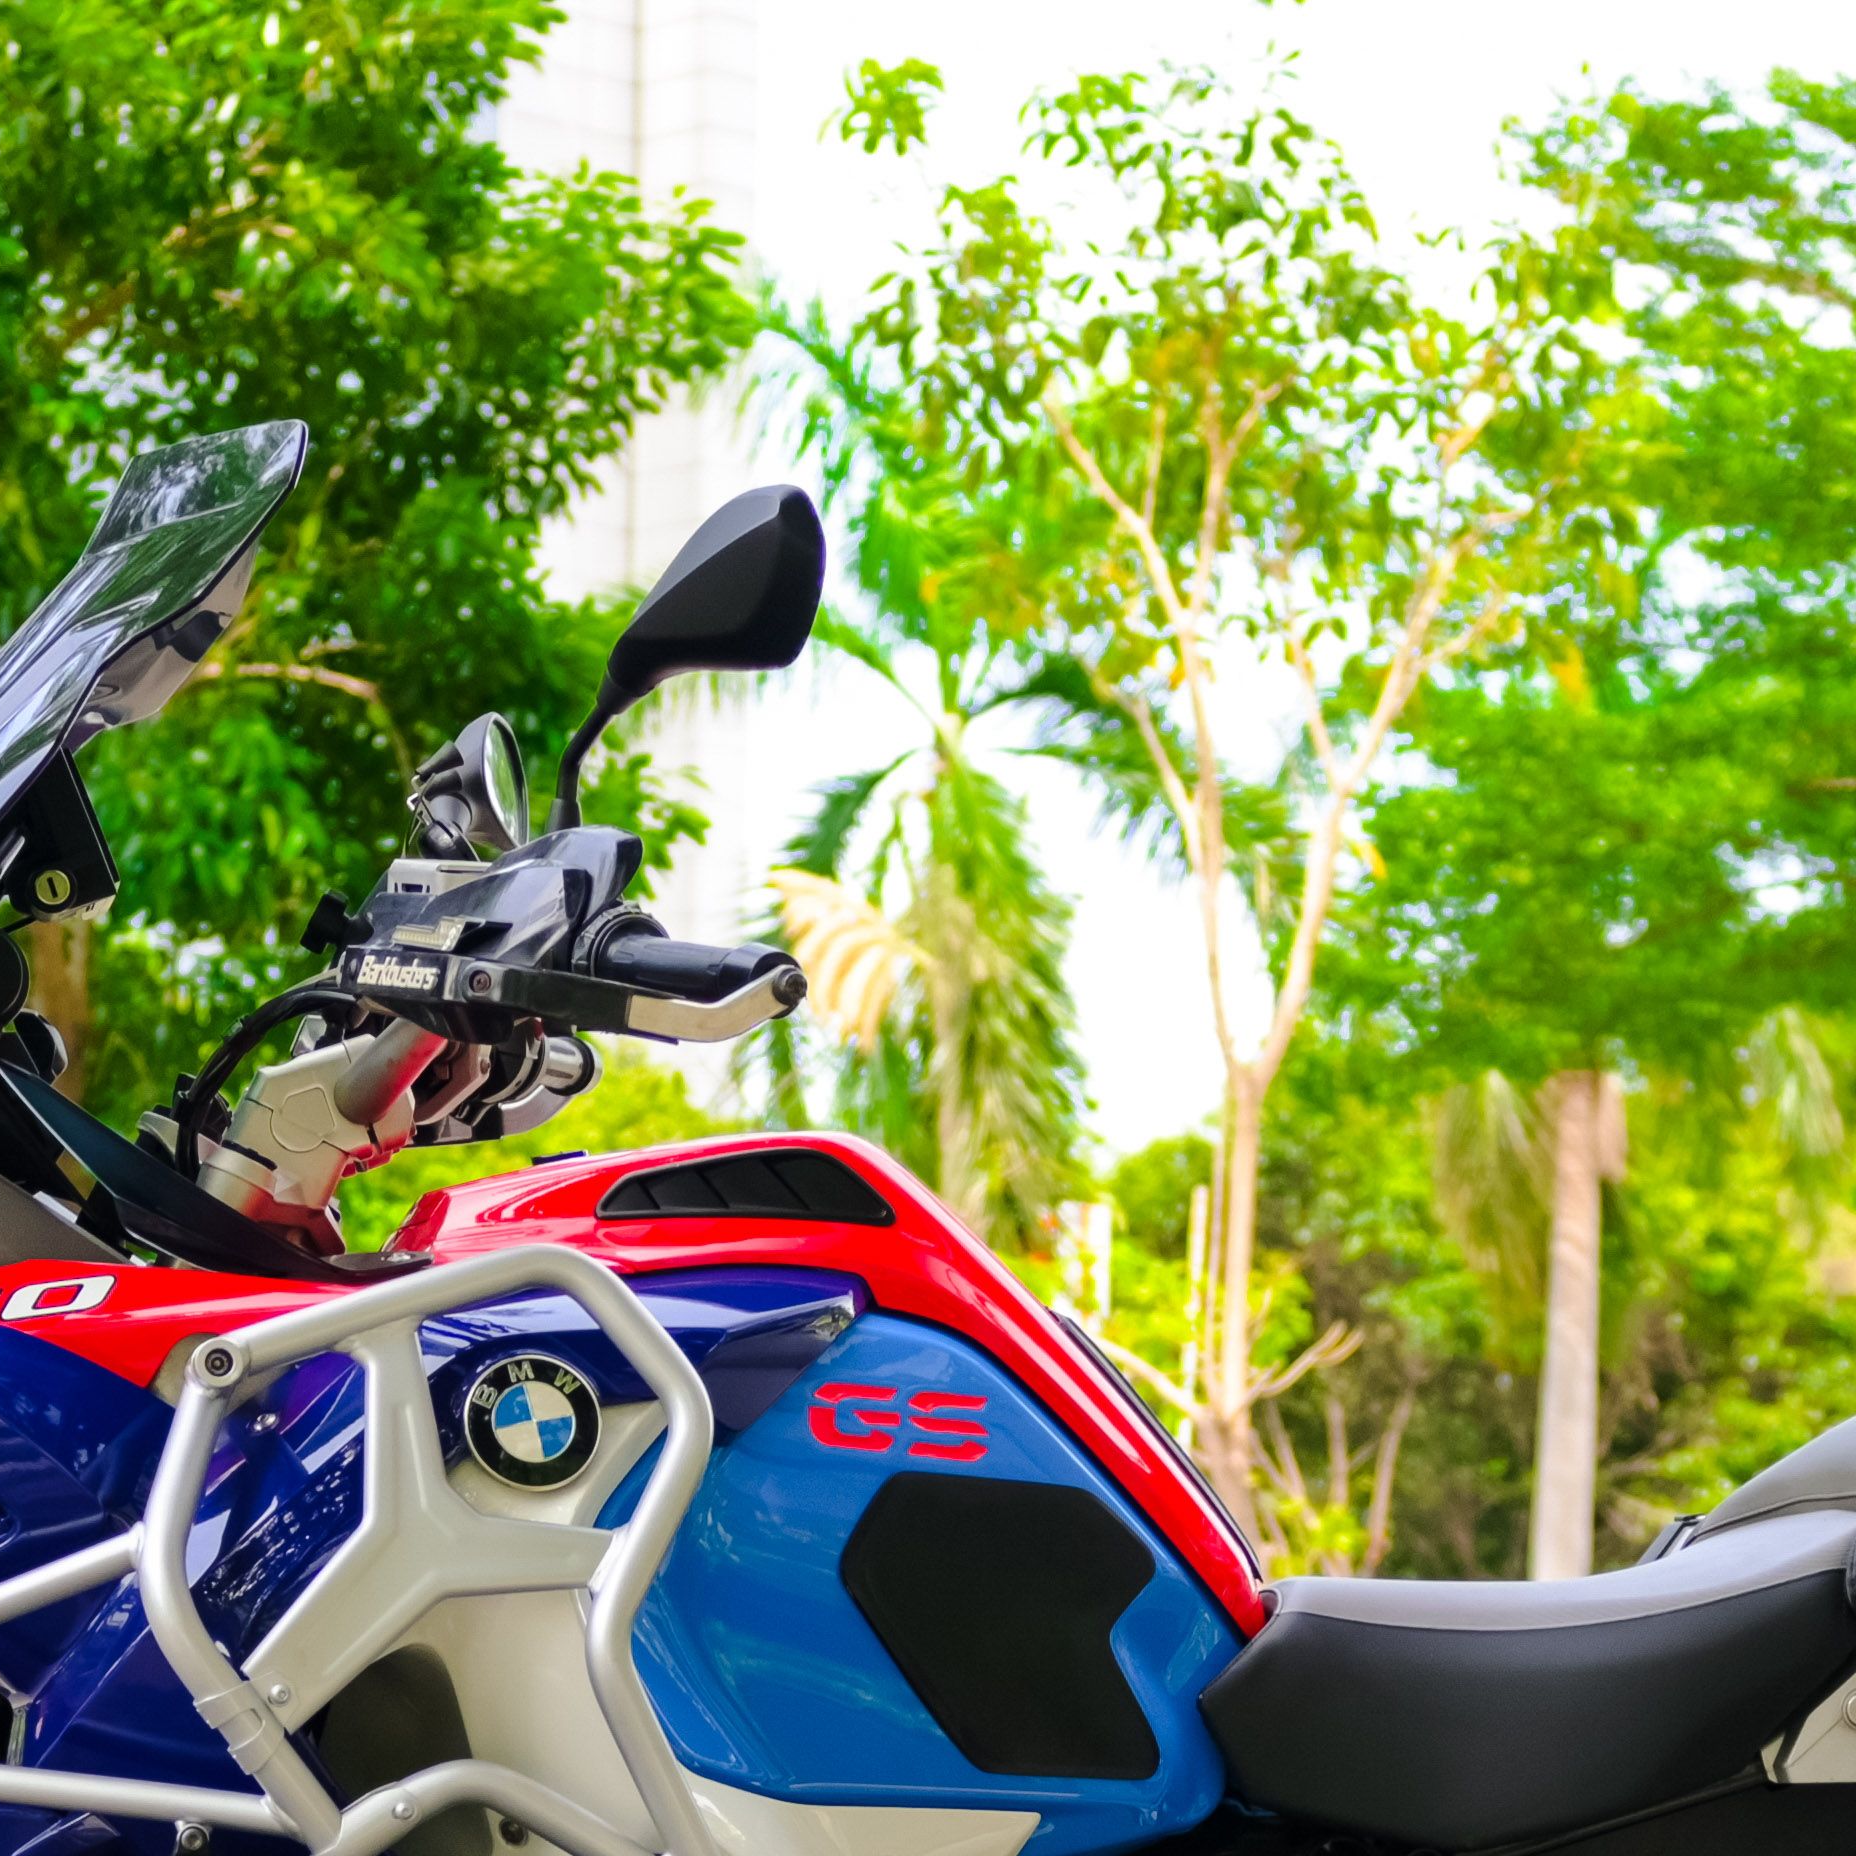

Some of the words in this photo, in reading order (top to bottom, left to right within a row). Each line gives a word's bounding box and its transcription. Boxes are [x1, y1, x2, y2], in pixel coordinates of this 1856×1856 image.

[357, 955, 441, 990] Barkbusters
[471, 1360, 581, 1409] BMW
[808, 1381, 989, 1463] GS
